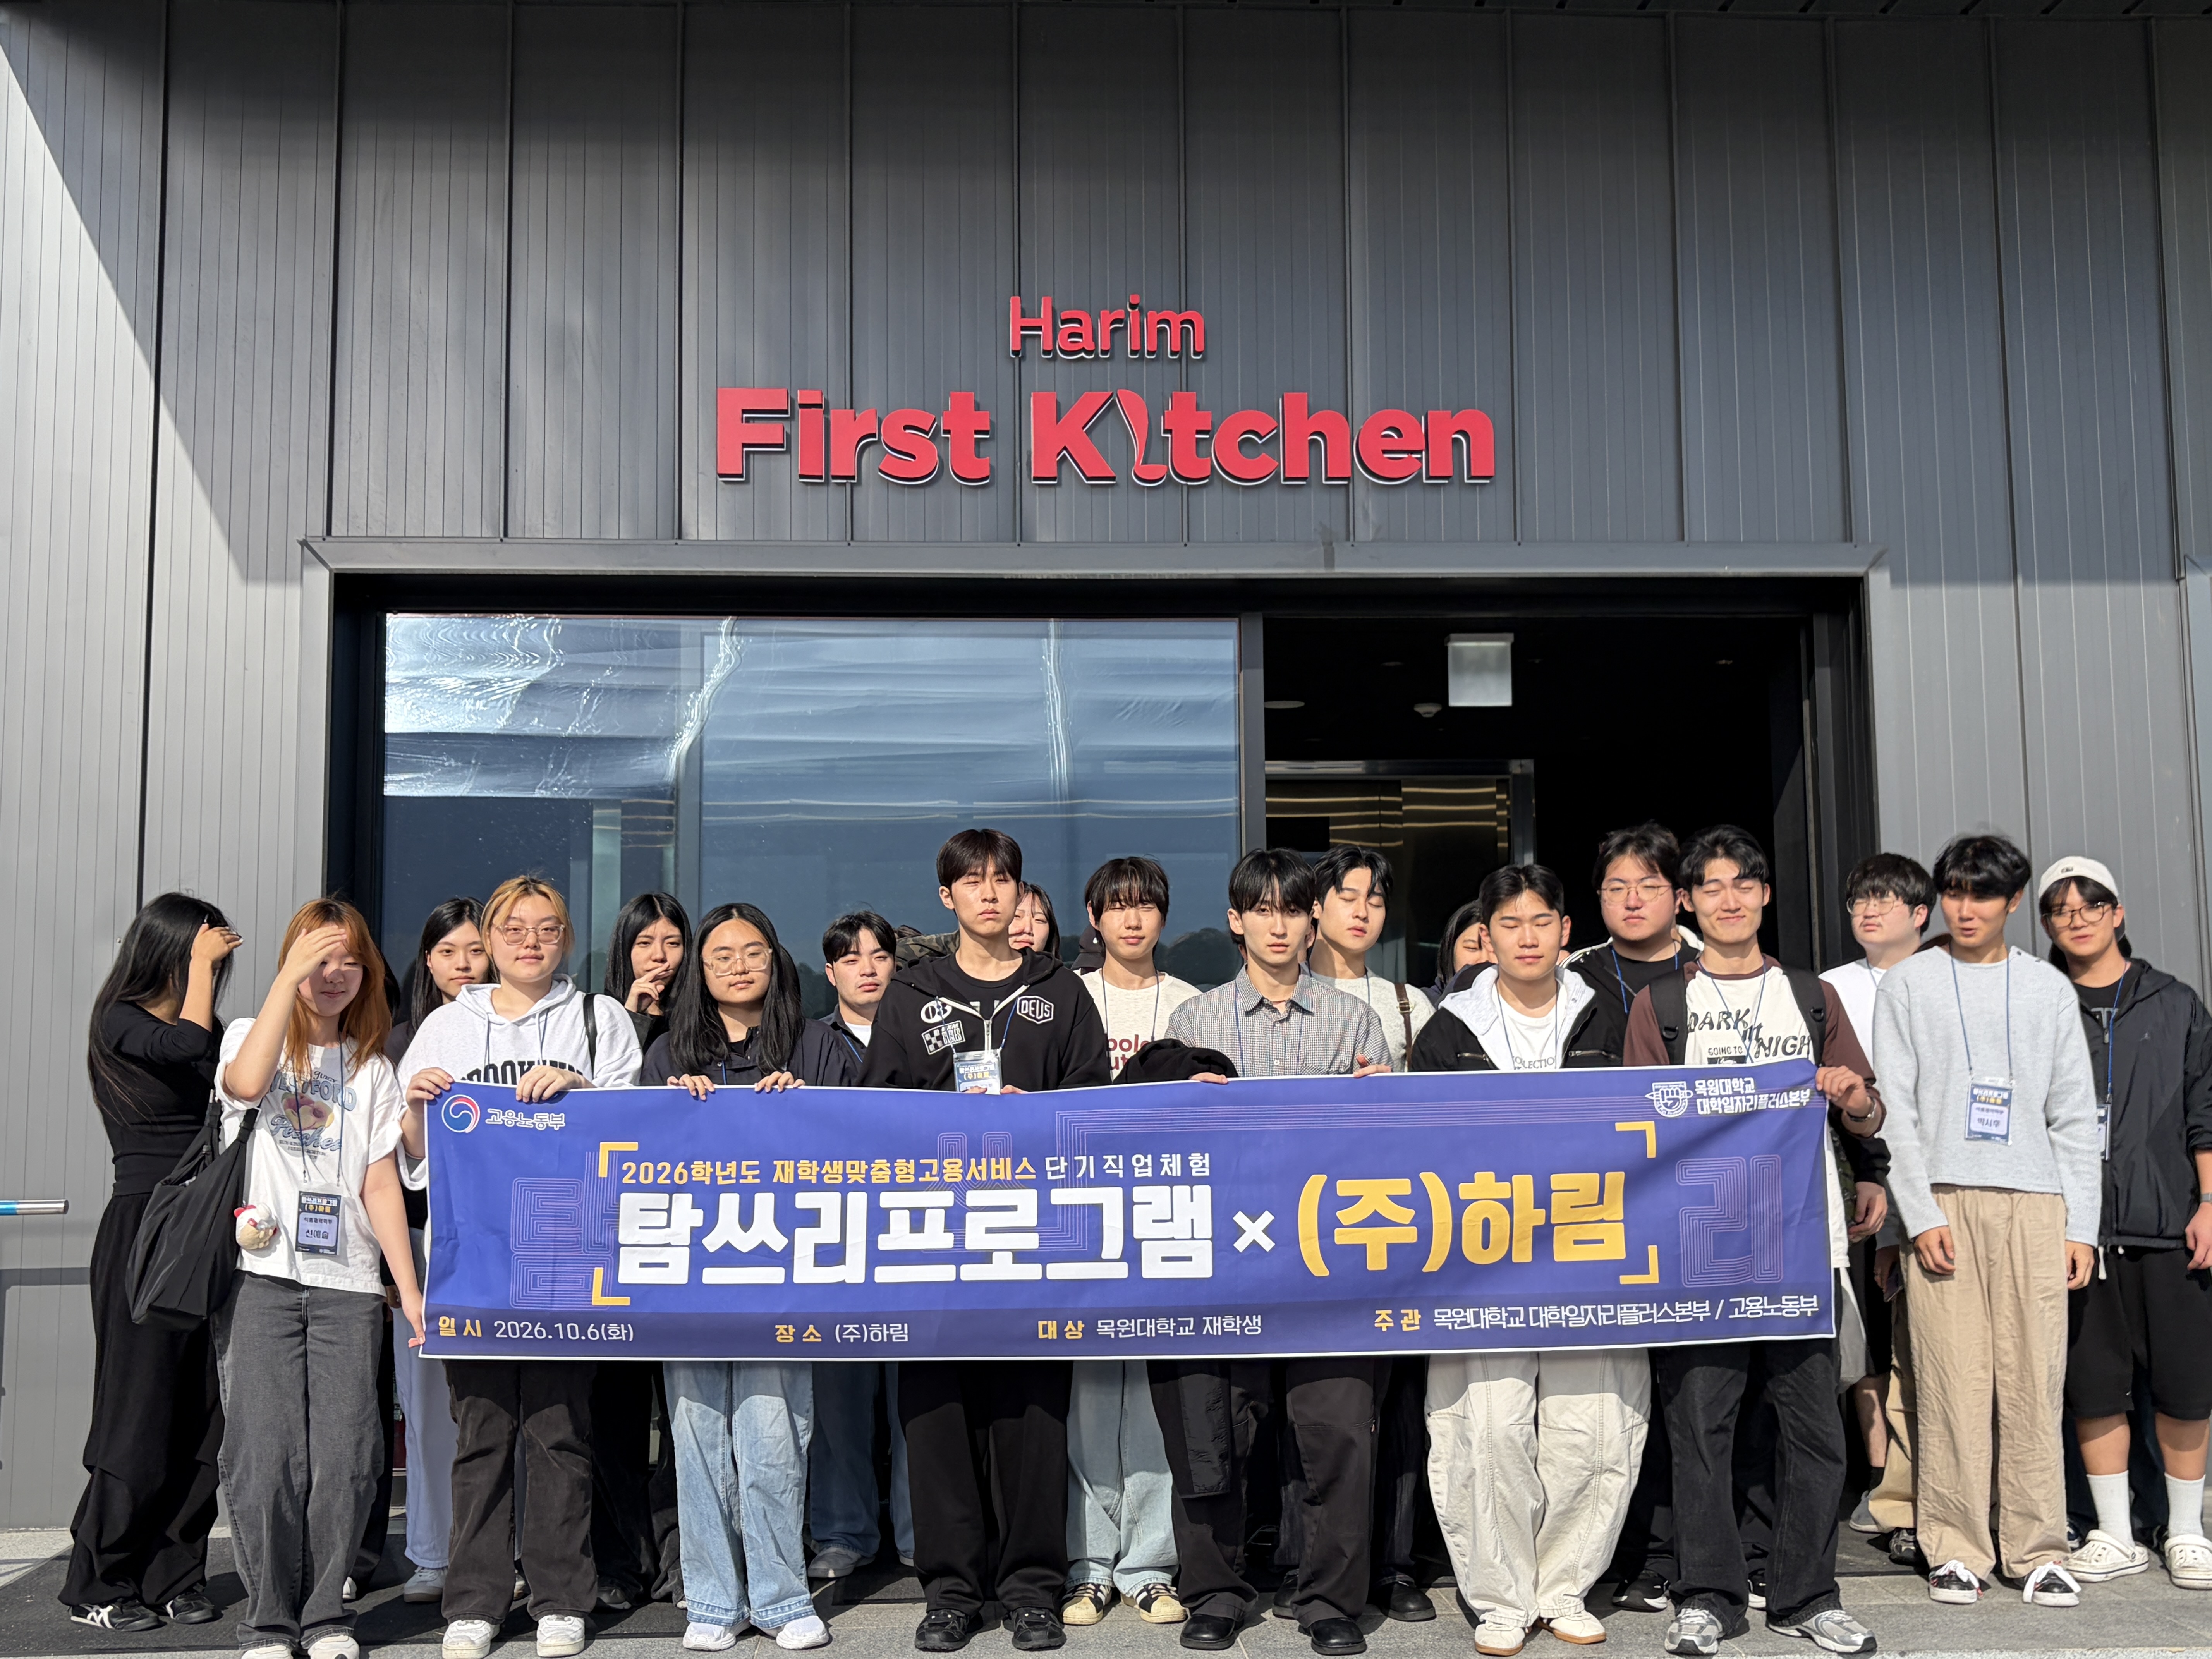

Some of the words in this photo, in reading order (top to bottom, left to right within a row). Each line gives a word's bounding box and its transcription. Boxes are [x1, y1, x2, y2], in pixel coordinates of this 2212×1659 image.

[1010, 295, 1205, 356] Harim
[717, 388, 990, 485] First
[1031, 388, 1496, 486] Kitchen
[1021, 1000, 1051, 1020] DEUS
[1688, 1008, 1750, 1033] DARK
[1695, 1077, 1755, 1096] 목원대학교
[1697, 1088, 1811, 1115] 대학일자리플러스본부
[485, 1108, 565, 1130] 고용노동부
[622, 1161, 761, 1185] 2026학년도
[773, 1157, 1036, 1184] 재학생맞춤형고용서비스
[618, 1185, 1213, 1284] 탐쓰리프로그램
[1298, 1171, 1625, 1277] (주)하림
[1434, 1306, 1527, 1330] 목원대학교
[1528, 1300, 1711, 1328] 대학일자리플러스본부
[1728, 1295, 1819, 1319] 고용노동부
[494, 1321, 634, 1341] 2026.10.6(화)
[835, 1323, 908, 1343] (주)하림
[1096, 1317, 1195, 1338] 목원대학교
[1202, 1314, 1262, 1336] 재학생
